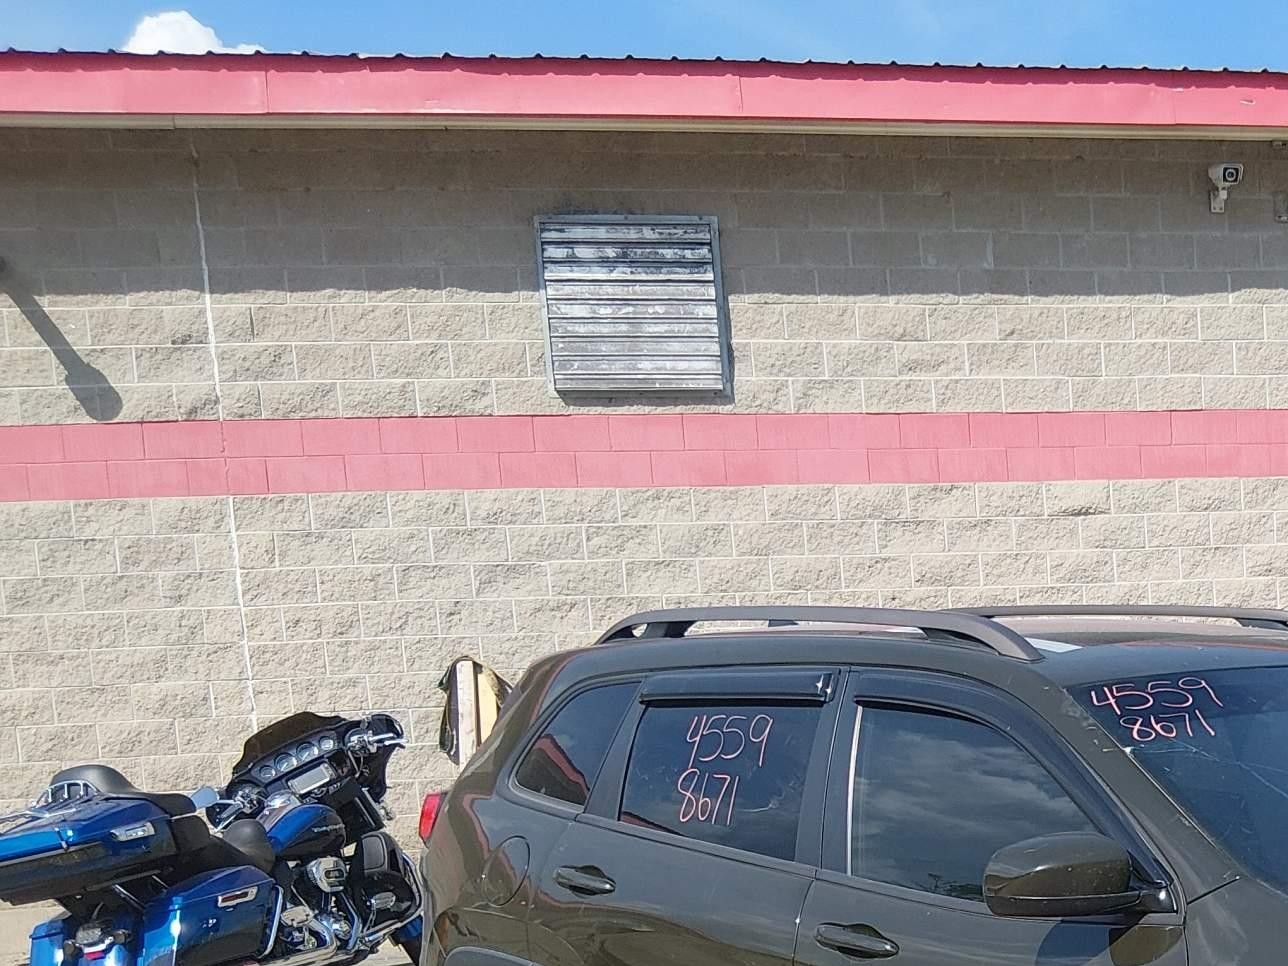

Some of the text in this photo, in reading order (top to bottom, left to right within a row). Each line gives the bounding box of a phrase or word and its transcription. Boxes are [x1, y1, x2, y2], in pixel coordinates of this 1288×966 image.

[1091, 677, 1224, 715] 4559
[686, 713, 774, 770] 4559
[1119, 709, 1216, 742] 8671
[677, 768, 739, 827] 8671
